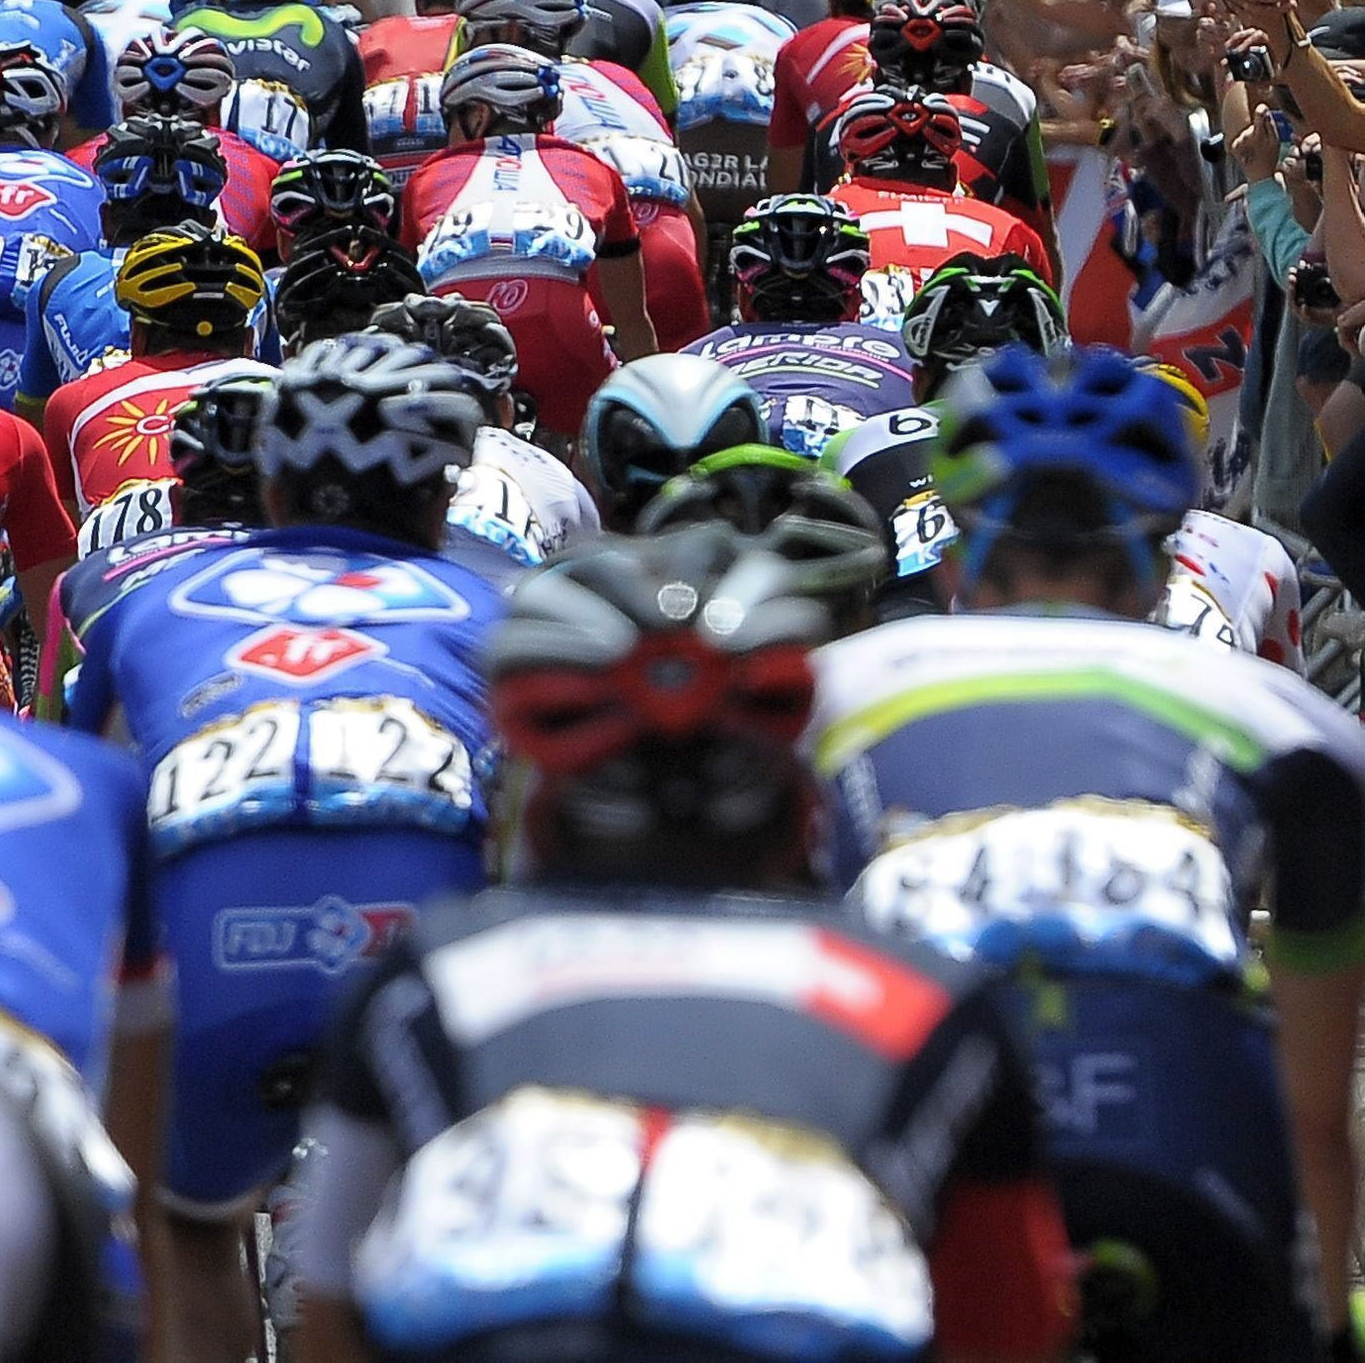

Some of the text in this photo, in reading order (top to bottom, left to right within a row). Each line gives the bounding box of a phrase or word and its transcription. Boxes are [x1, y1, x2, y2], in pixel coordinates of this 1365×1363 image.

[85, 487, 164, 558] 178
[917, 505, 947, 544] 6
[151, 718, 283, 824] 122
